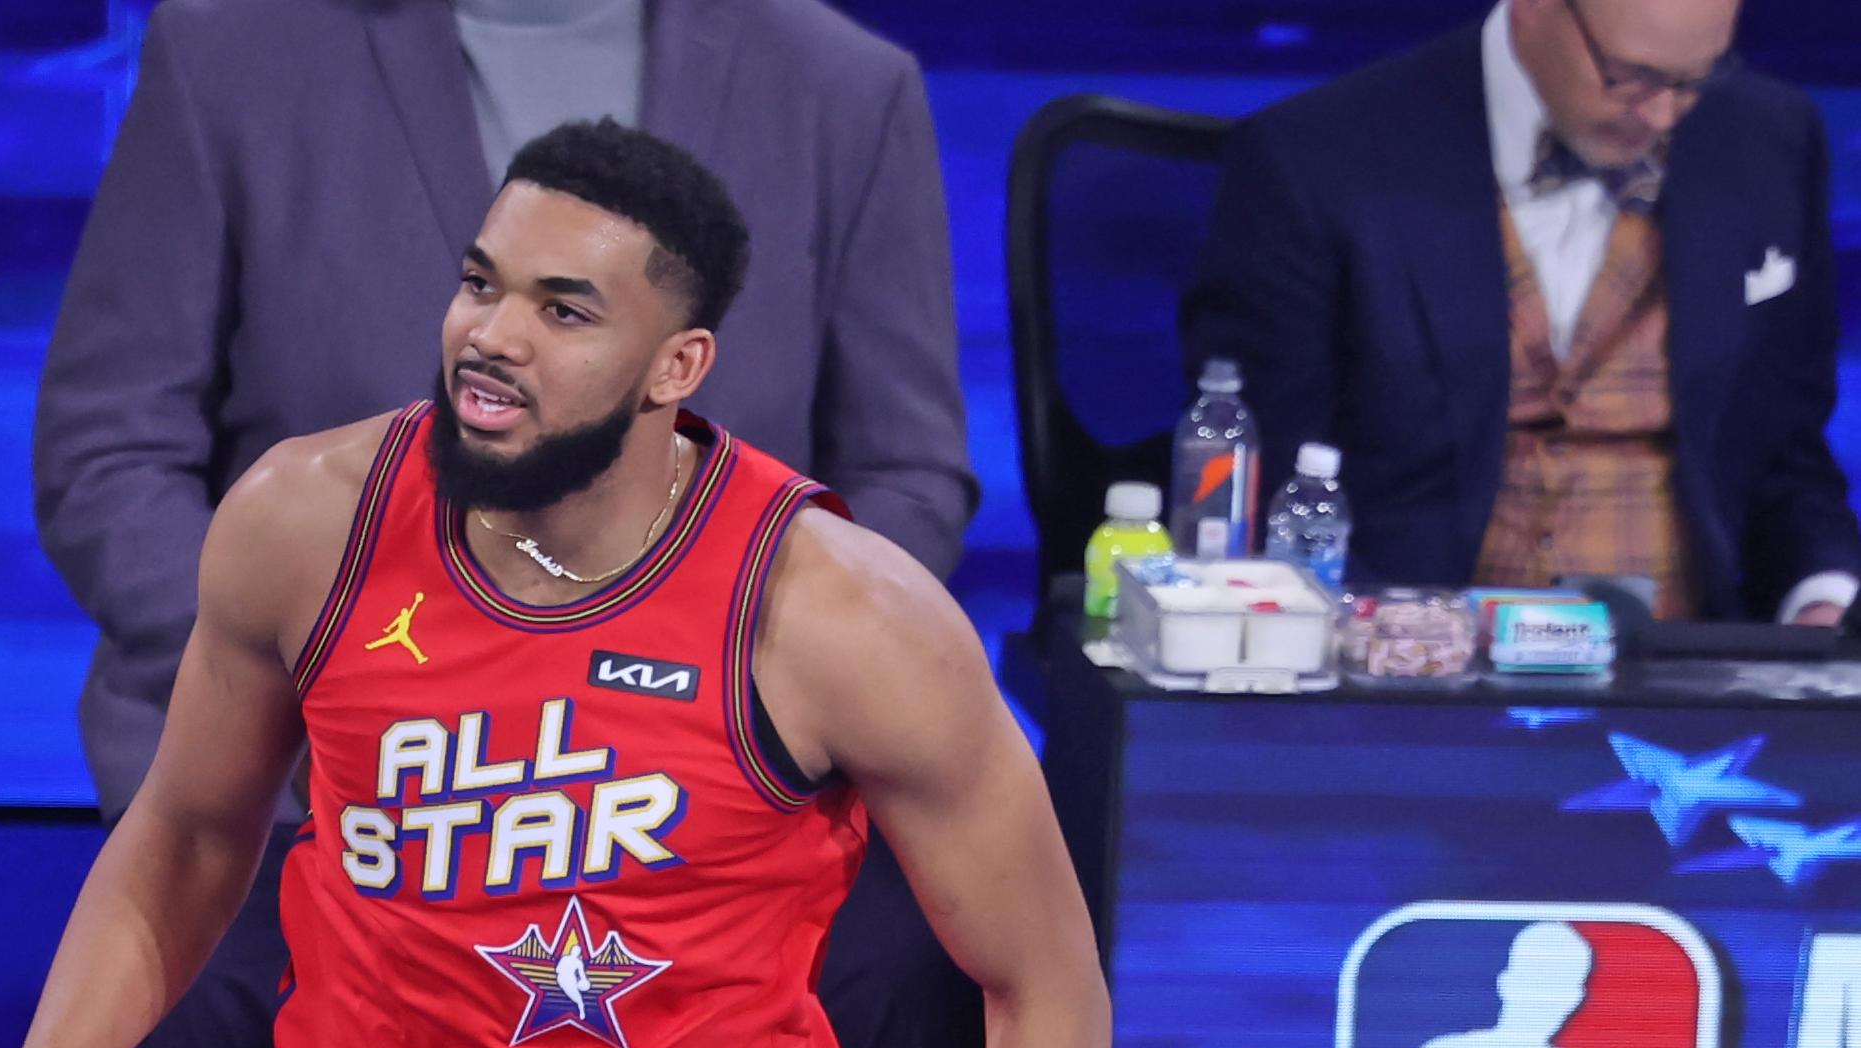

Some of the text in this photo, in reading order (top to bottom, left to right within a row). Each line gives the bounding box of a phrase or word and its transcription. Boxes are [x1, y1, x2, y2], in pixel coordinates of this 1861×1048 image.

[598, 658, 690, 692] KIA
[376, 697, 616, 808] ALL
[340, 772, 688, 899] STAR
